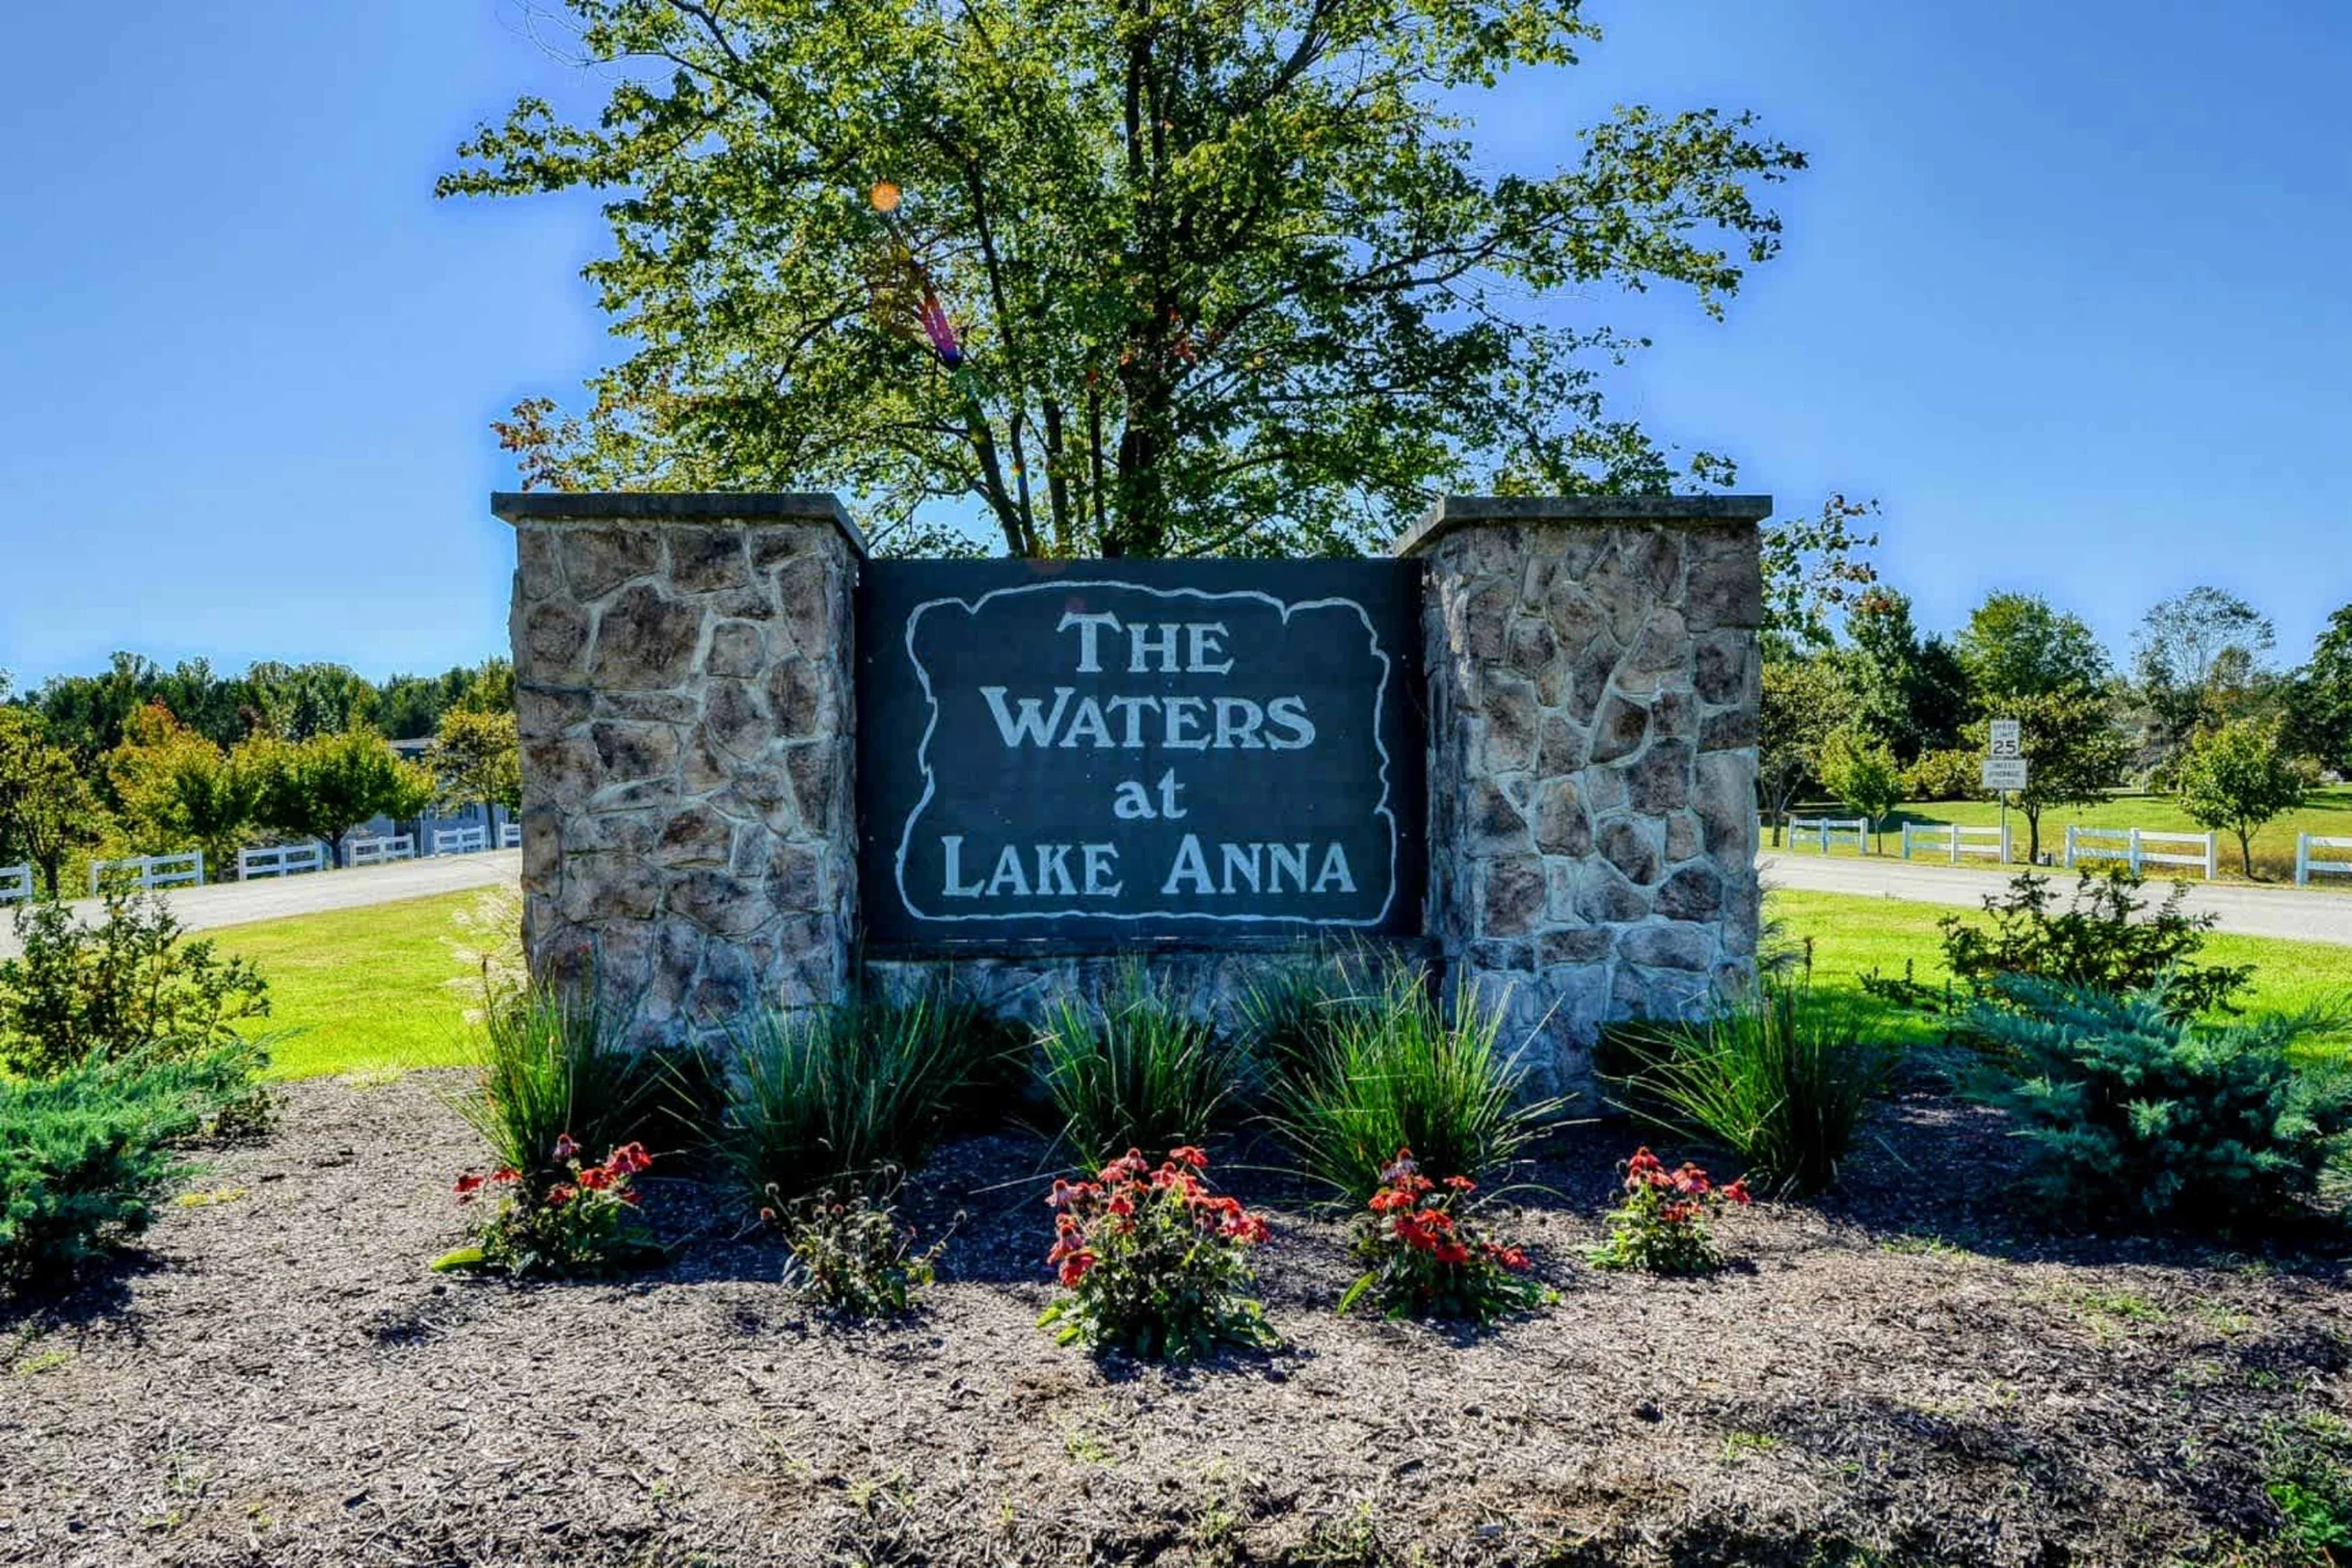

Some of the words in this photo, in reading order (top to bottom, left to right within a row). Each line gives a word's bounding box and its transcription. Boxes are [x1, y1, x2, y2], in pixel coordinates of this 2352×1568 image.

[1057, 612, 1234, 675] THE
[979, 685, 1317, 751] WATERS
[1993, 739, 2017, 755] 25
[1113, 768, 1189, 820] at
[941, 835, 1123, 898] LAKE
[1161, 834, 1357, 894] ANNA
